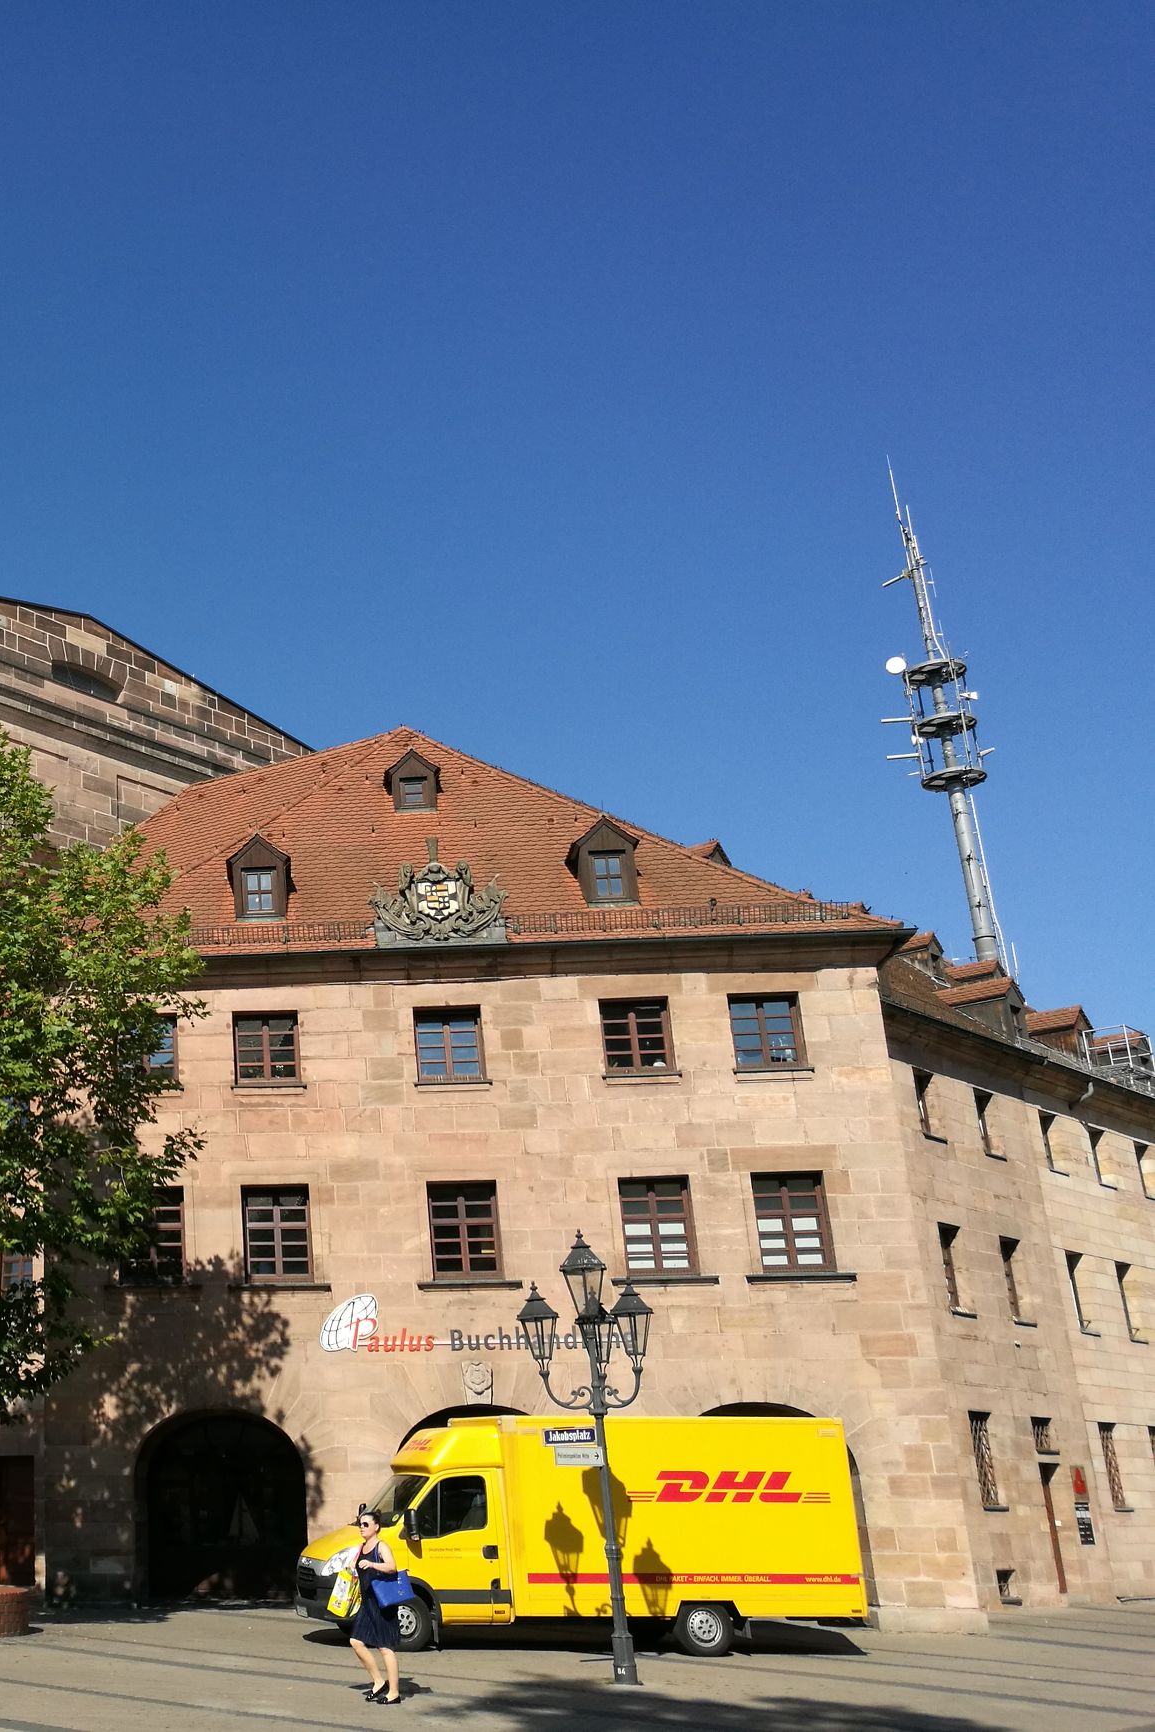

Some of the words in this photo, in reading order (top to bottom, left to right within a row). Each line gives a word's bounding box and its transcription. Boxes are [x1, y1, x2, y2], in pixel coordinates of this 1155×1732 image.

[344, 1317, 435, 1352] Paulus
[549, 1430, 591, 1442] Jakobsplatz
[656, 1470, 802, 1503] DHL
[694, 1575, 719, 1583] EINFACH.
[721, 1575, 743, 1583] IMMER.
[744, 1574, 771, 1583] ÜBERALL.
